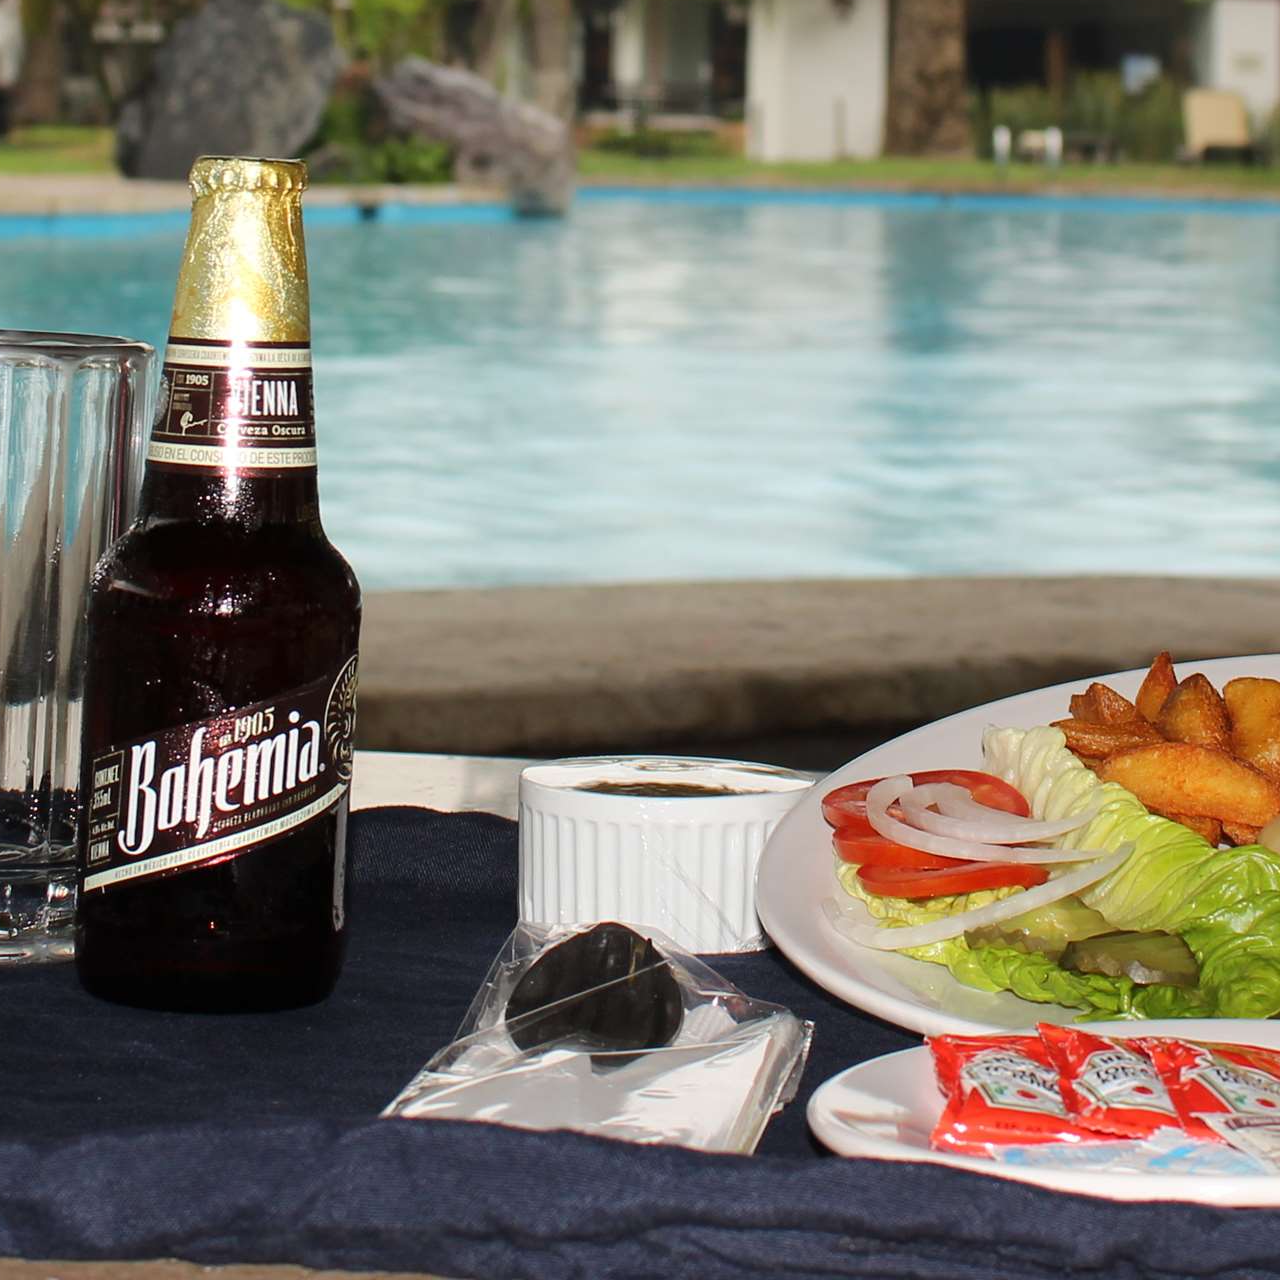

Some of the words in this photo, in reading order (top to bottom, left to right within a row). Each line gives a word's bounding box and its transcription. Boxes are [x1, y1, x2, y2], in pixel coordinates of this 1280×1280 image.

[185, 374, 209, 386] 1905
[233, 706, 276, 744] 1905
[117, 709, 323, 856] Bohemia
